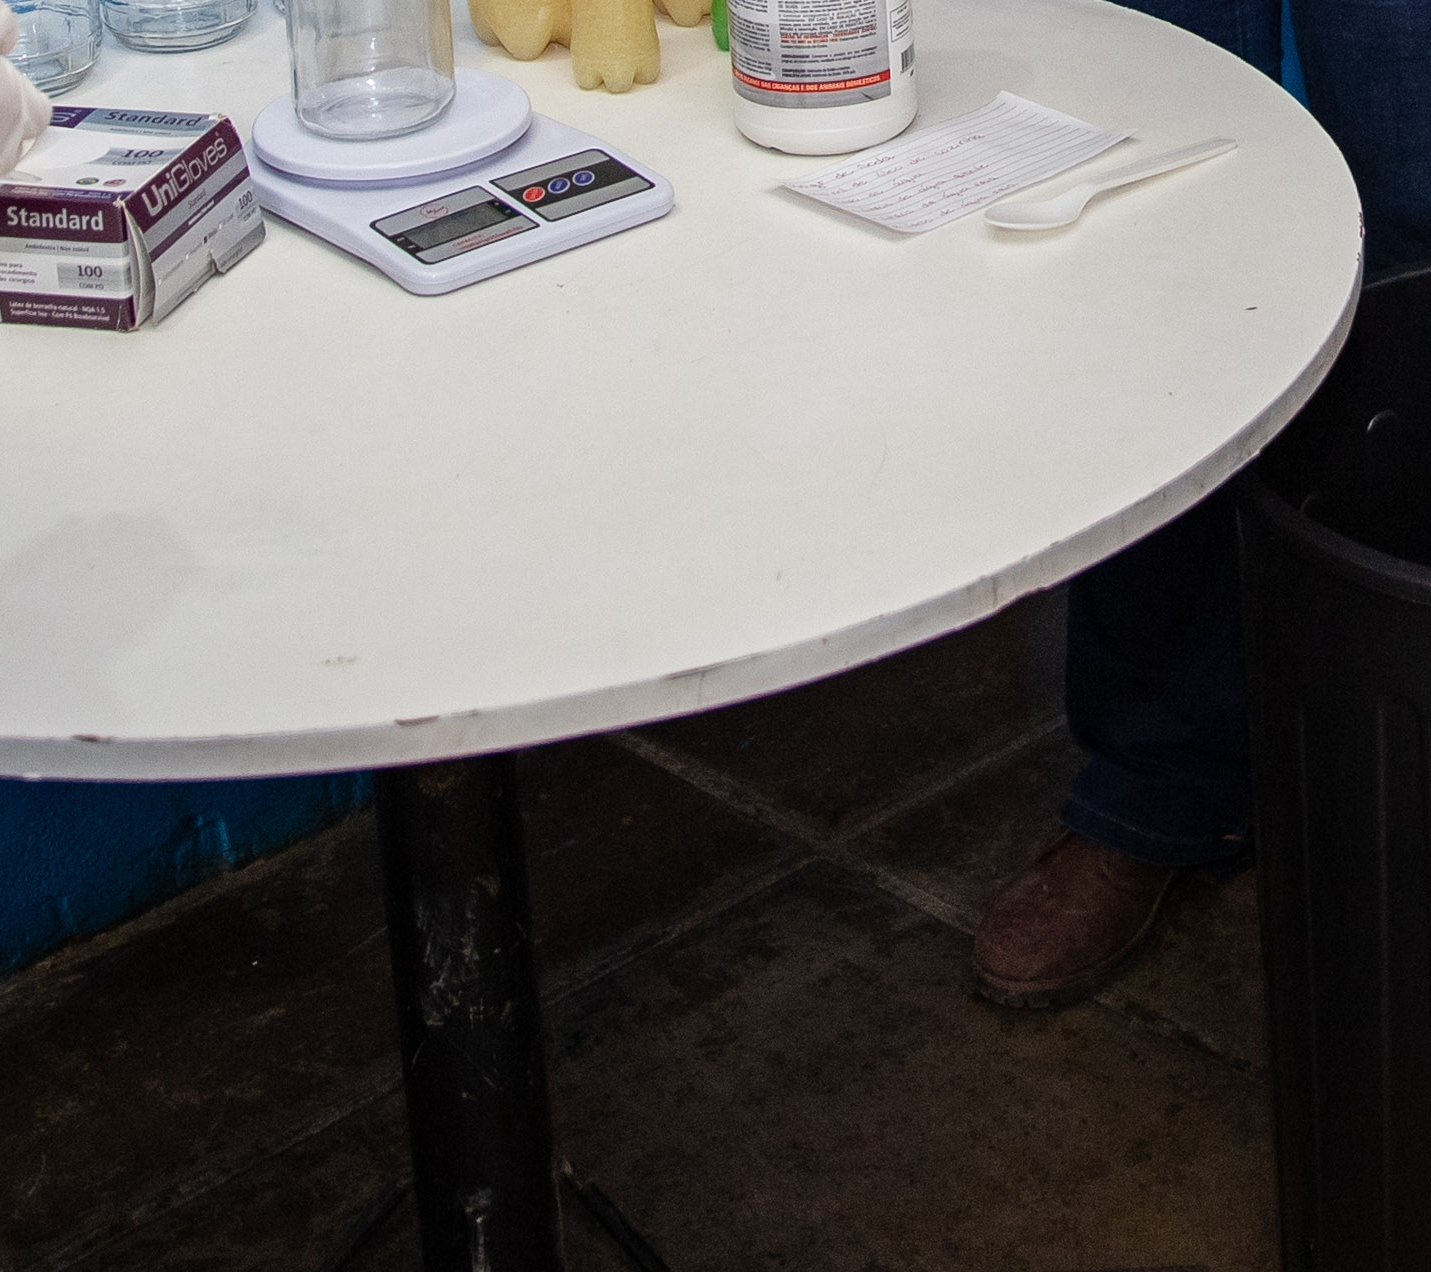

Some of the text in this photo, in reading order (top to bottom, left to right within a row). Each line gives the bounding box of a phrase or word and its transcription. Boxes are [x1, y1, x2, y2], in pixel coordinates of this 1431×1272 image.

[104, 111, 202, 127] Standard
[124, 149, 165, 158] 100
[142, 137, 228, 217] UniGloves
[238, 191, 253, 210] 100
[6, 206, 104, 232] Standard
[77, 265, 103, 278] 100
